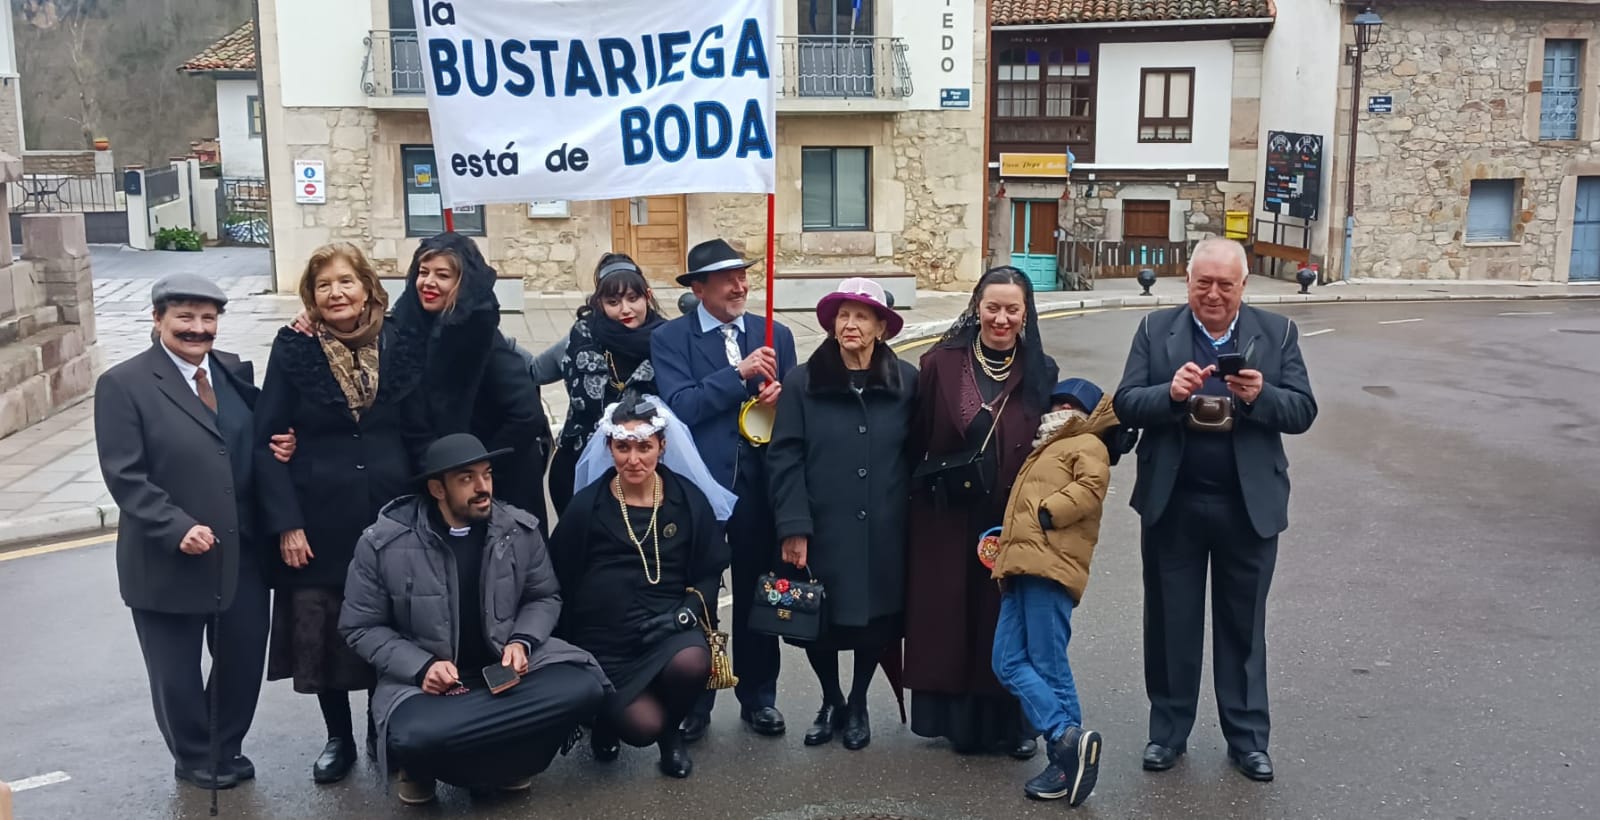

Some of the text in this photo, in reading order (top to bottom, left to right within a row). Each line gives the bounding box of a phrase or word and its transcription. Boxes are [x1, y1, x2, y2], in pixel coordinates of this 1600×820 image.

[423, 0, 456, 27] la
[428, 18, 771, 98] BUSTARIEGA
[451, 98, 774, 178] está de BODA
